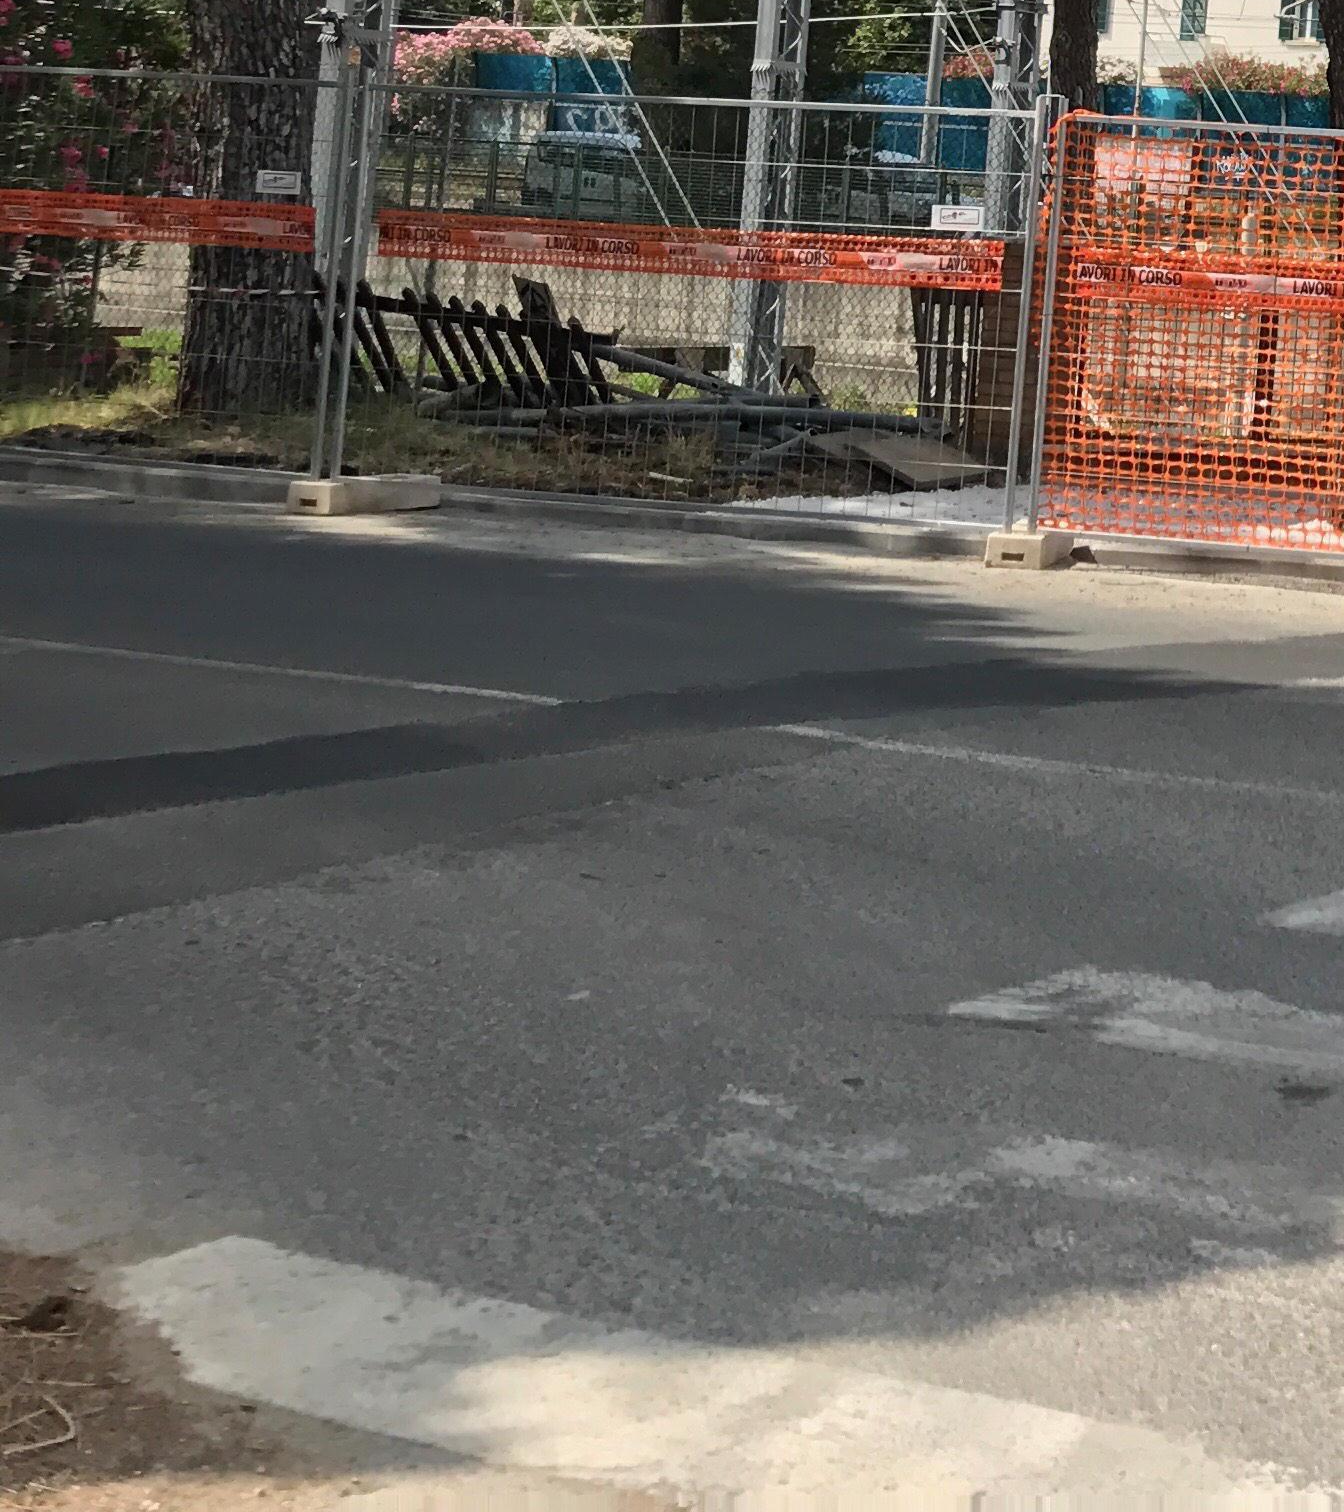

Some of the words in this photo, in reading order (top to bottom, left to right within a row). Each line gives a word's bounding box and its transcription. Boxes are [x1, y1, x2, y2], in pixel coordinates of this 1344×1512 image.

[415, 228, 452, 244] CORSO
[545, 234, 582, 251] LAVORI
[585, 237, 600, 253] IN
[601, 238, 640, 255] CORSO
[736, 246, 776, 263] LAVORI
[780, 248, 794, 264] IN
[798, 249, 837, 266] CORSO
[938, 256, 980, 272] LAVORI
[1120, 267, 1136, 282] IN
[1139, 269, 1183, 286] CORSO
[1292, 279, 1337, 297] LAVORI
